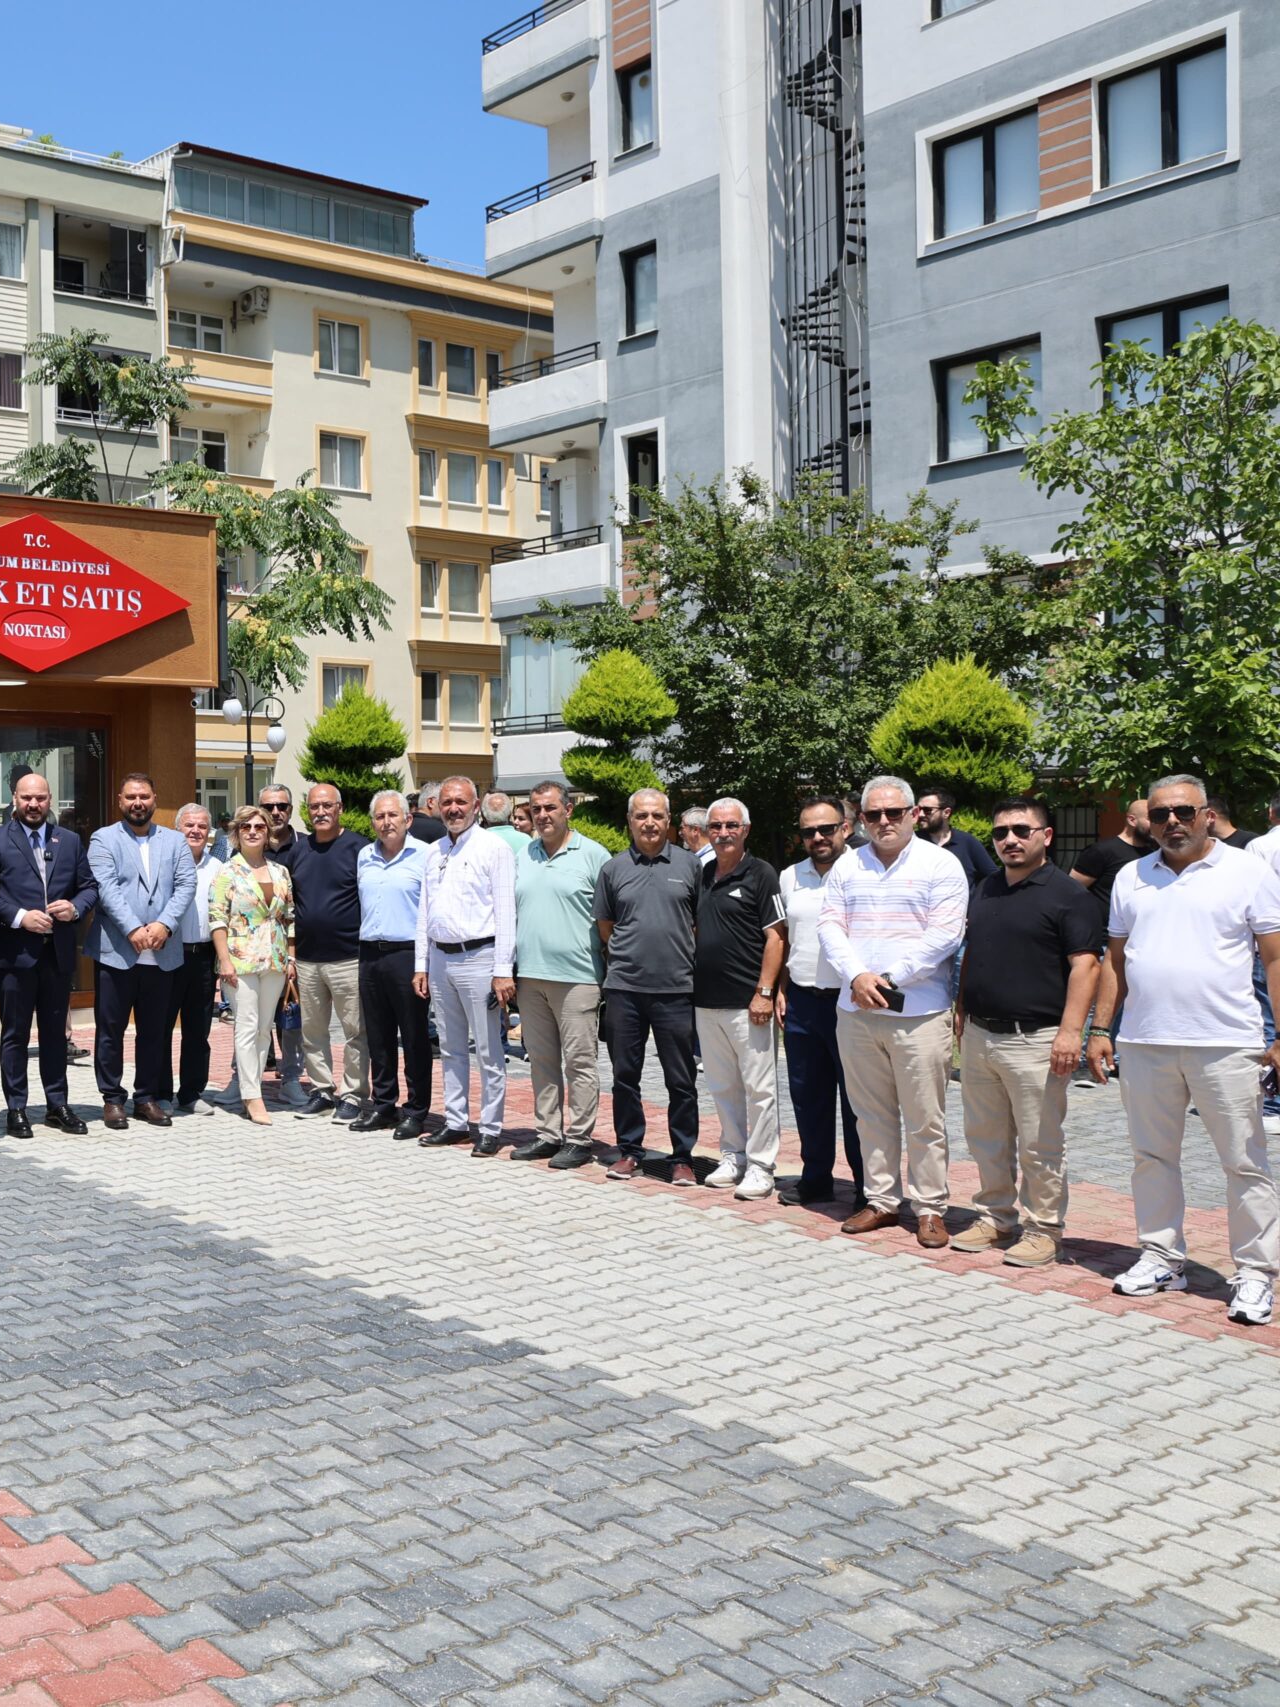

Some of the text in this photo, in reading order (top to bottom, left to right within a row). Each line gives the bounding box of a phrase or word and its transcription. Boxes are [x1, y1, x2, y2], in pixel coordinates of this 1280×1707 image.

[24, 533, 50, 548] T.C.
[22, 558, 110, 575] BELEDİYESİ
[16, 581, 55, 606] ET
[62, 585, 142, 617] SATIŞ
[4, 623, 66, 639] NOKTASI
